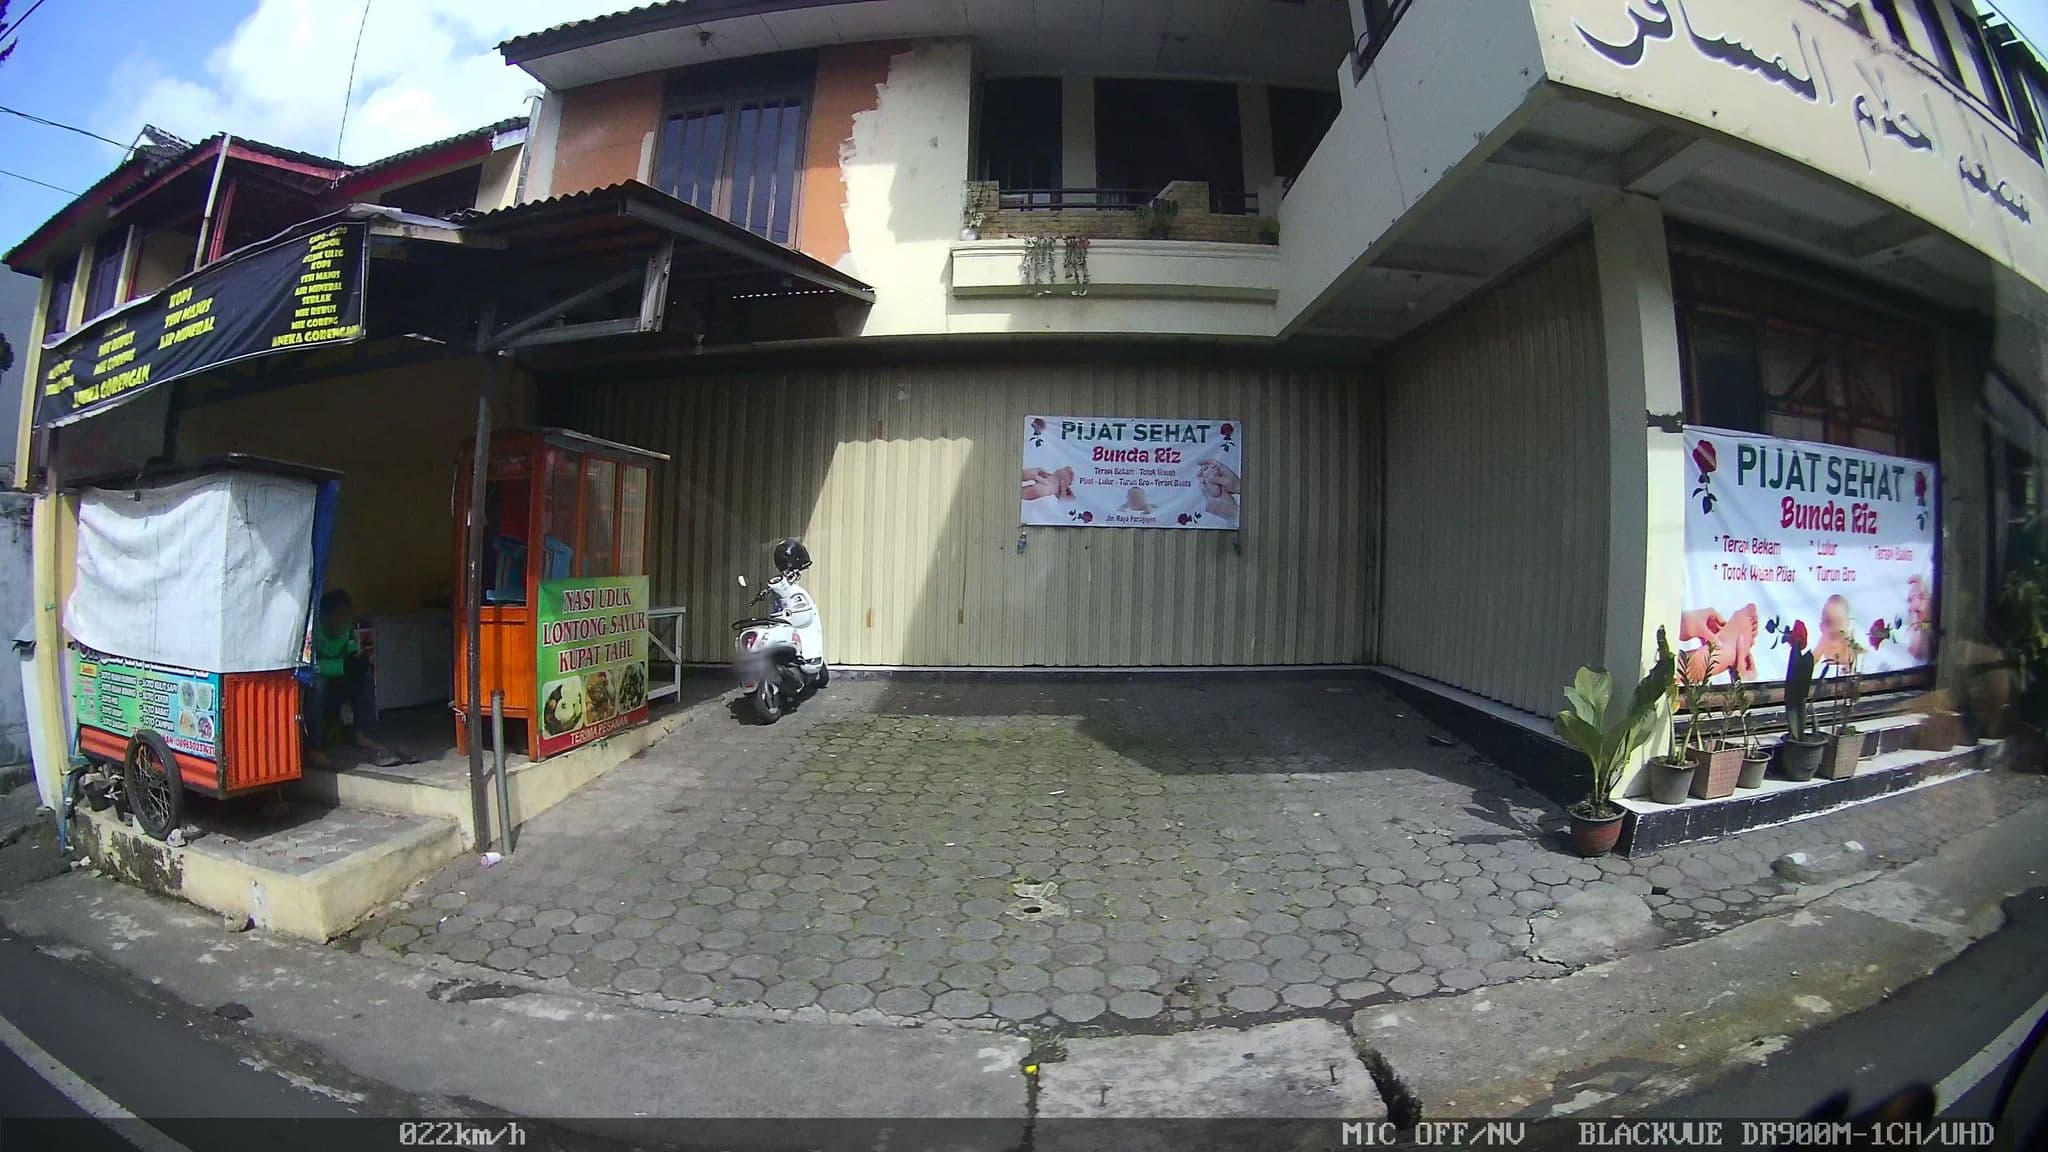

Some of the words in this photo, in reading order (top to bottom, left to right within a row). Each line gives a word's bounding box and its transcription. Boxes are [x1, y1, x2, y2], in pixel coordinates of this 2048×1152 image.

[271, 333, 303, 347] ANEKA
[100, 363, 151, 398] GORENGAN
[1133, 423, 1211, 443] SEHAT
[1092, 446, 1149, 464] Bunda
[1154, 447, 1182, 464] Riz
[1826, 456, 1904, 502] SEHAT
[1780, 495, 1846, 532] Bunda
[1850, 503, 1878, 535] Riz
[1752, 536, 1781, 556] Bekam
[563, 588, 596, 613] NASI
[599, 587, 632, 609] UDUK
[542, 617, 606, 647] LONTONG
[610, 611, 646, 635] SAYUR
[558, 646, 600, 674] KUPAT
[604, 639, 635, 662] TAHU
[570, 726, 598, 745] TERIMA
